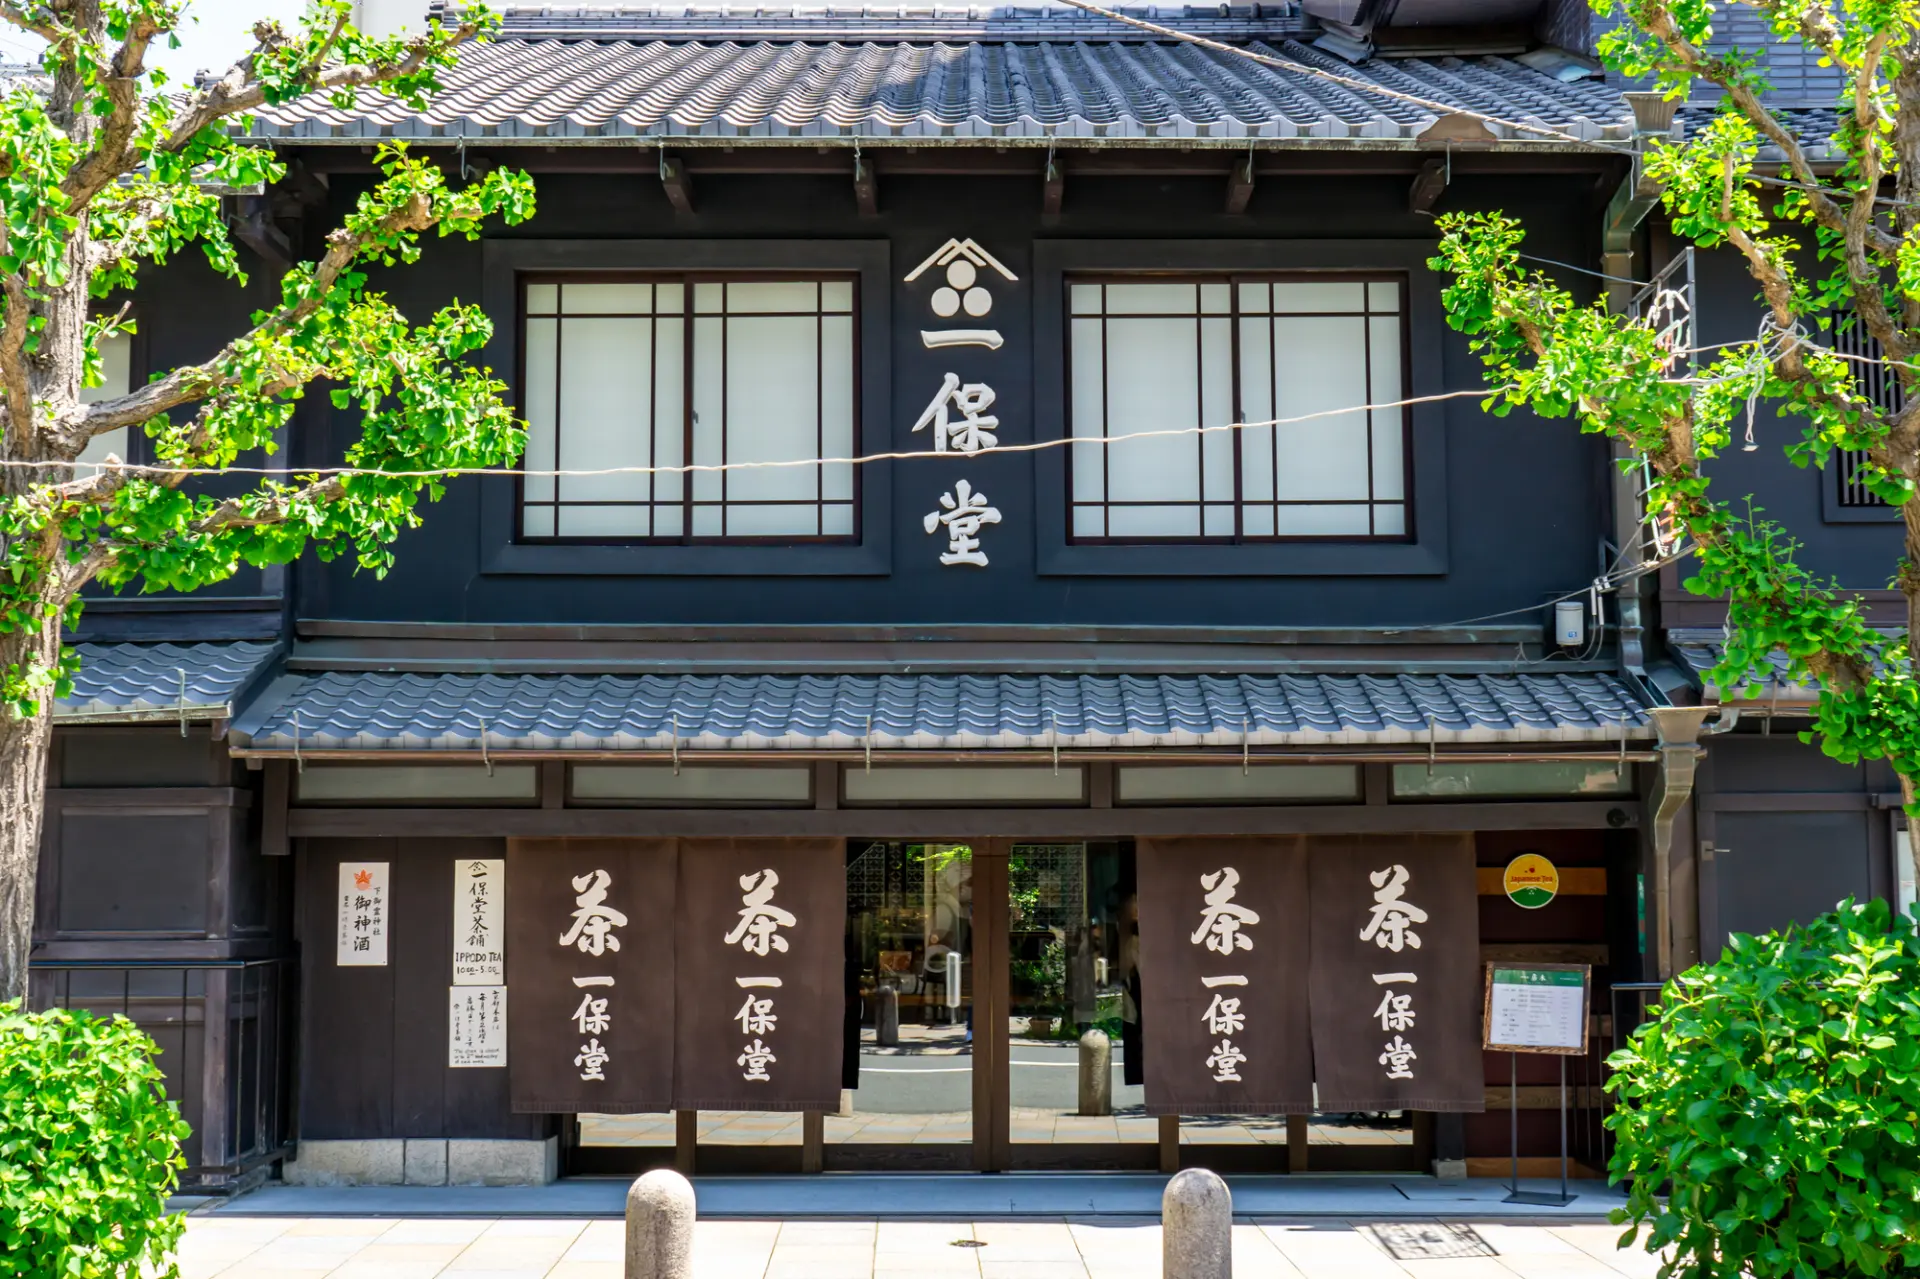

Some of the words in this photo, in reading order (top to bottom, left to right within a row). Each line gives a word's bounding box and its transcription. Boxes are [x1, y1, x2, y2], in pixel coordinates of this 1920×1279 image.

[911, 328, 1005, 567] 一保堂
[353, 895, 372, 953] 御神酒
[455, 952, 487, 963] IPPODO
[489, 951, 502, 963] TEA
